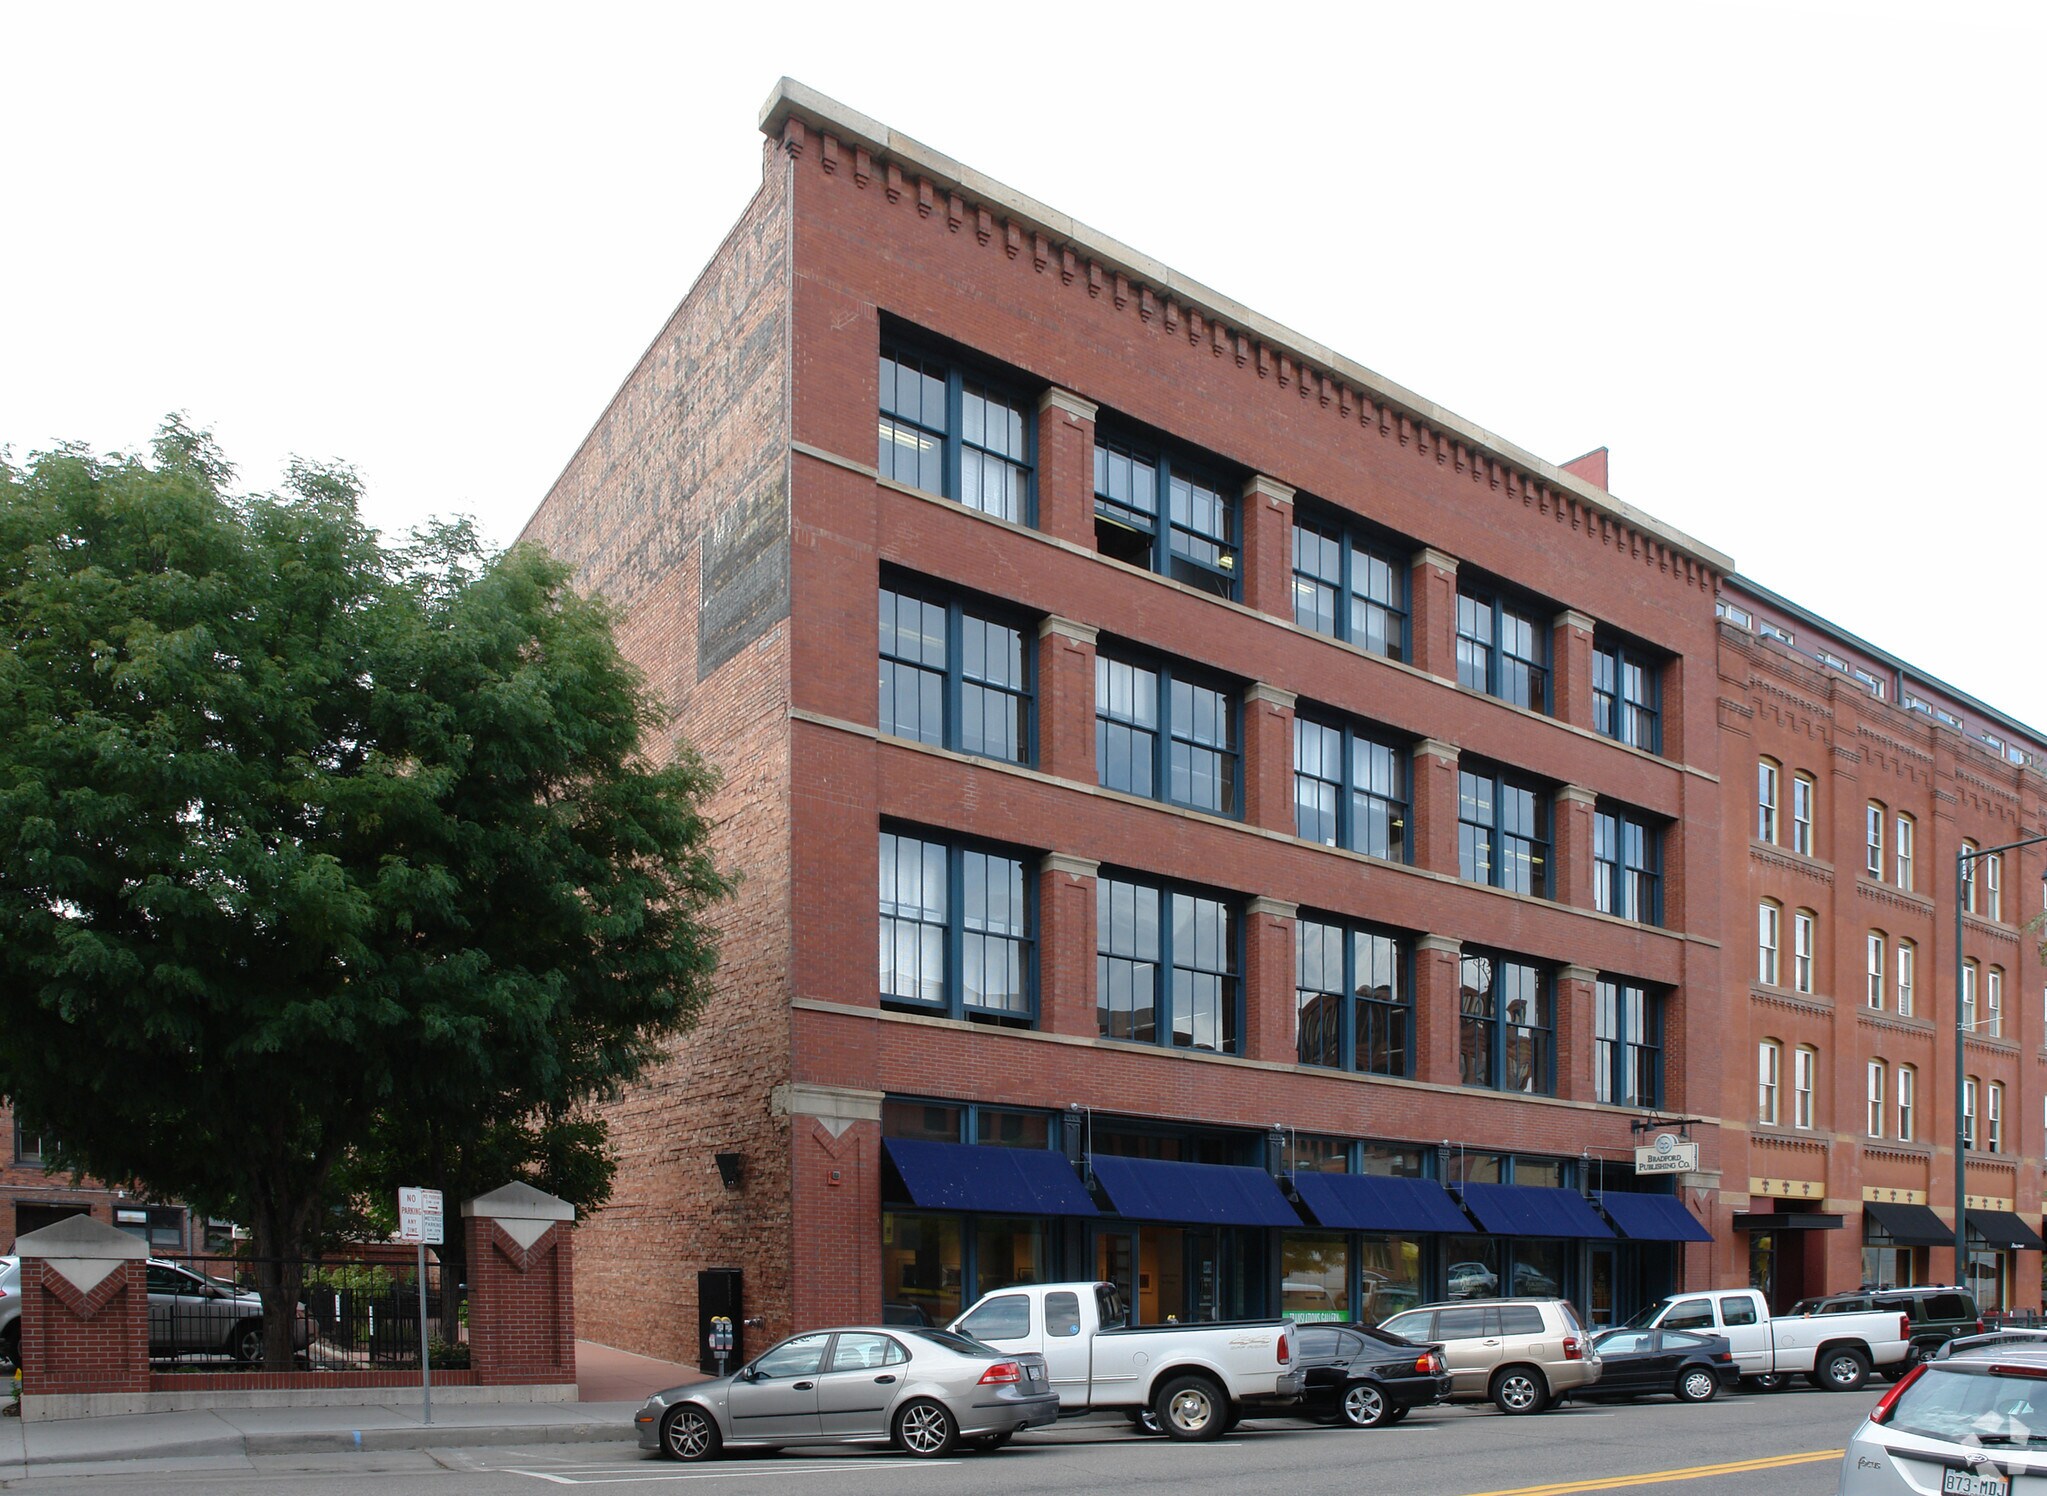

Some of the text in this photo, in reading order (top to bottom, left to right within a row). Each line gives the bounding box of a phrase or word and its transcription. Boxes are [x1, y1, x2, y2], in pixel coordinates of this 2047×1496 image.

[1647, 1155, 1682, 1163] BRADFORD
[1638, 1162, 1676, 1171] PUBLISHING
[407, 1194, 416, 1203] NO
[402, 1206, 421, 1215] PARKING
